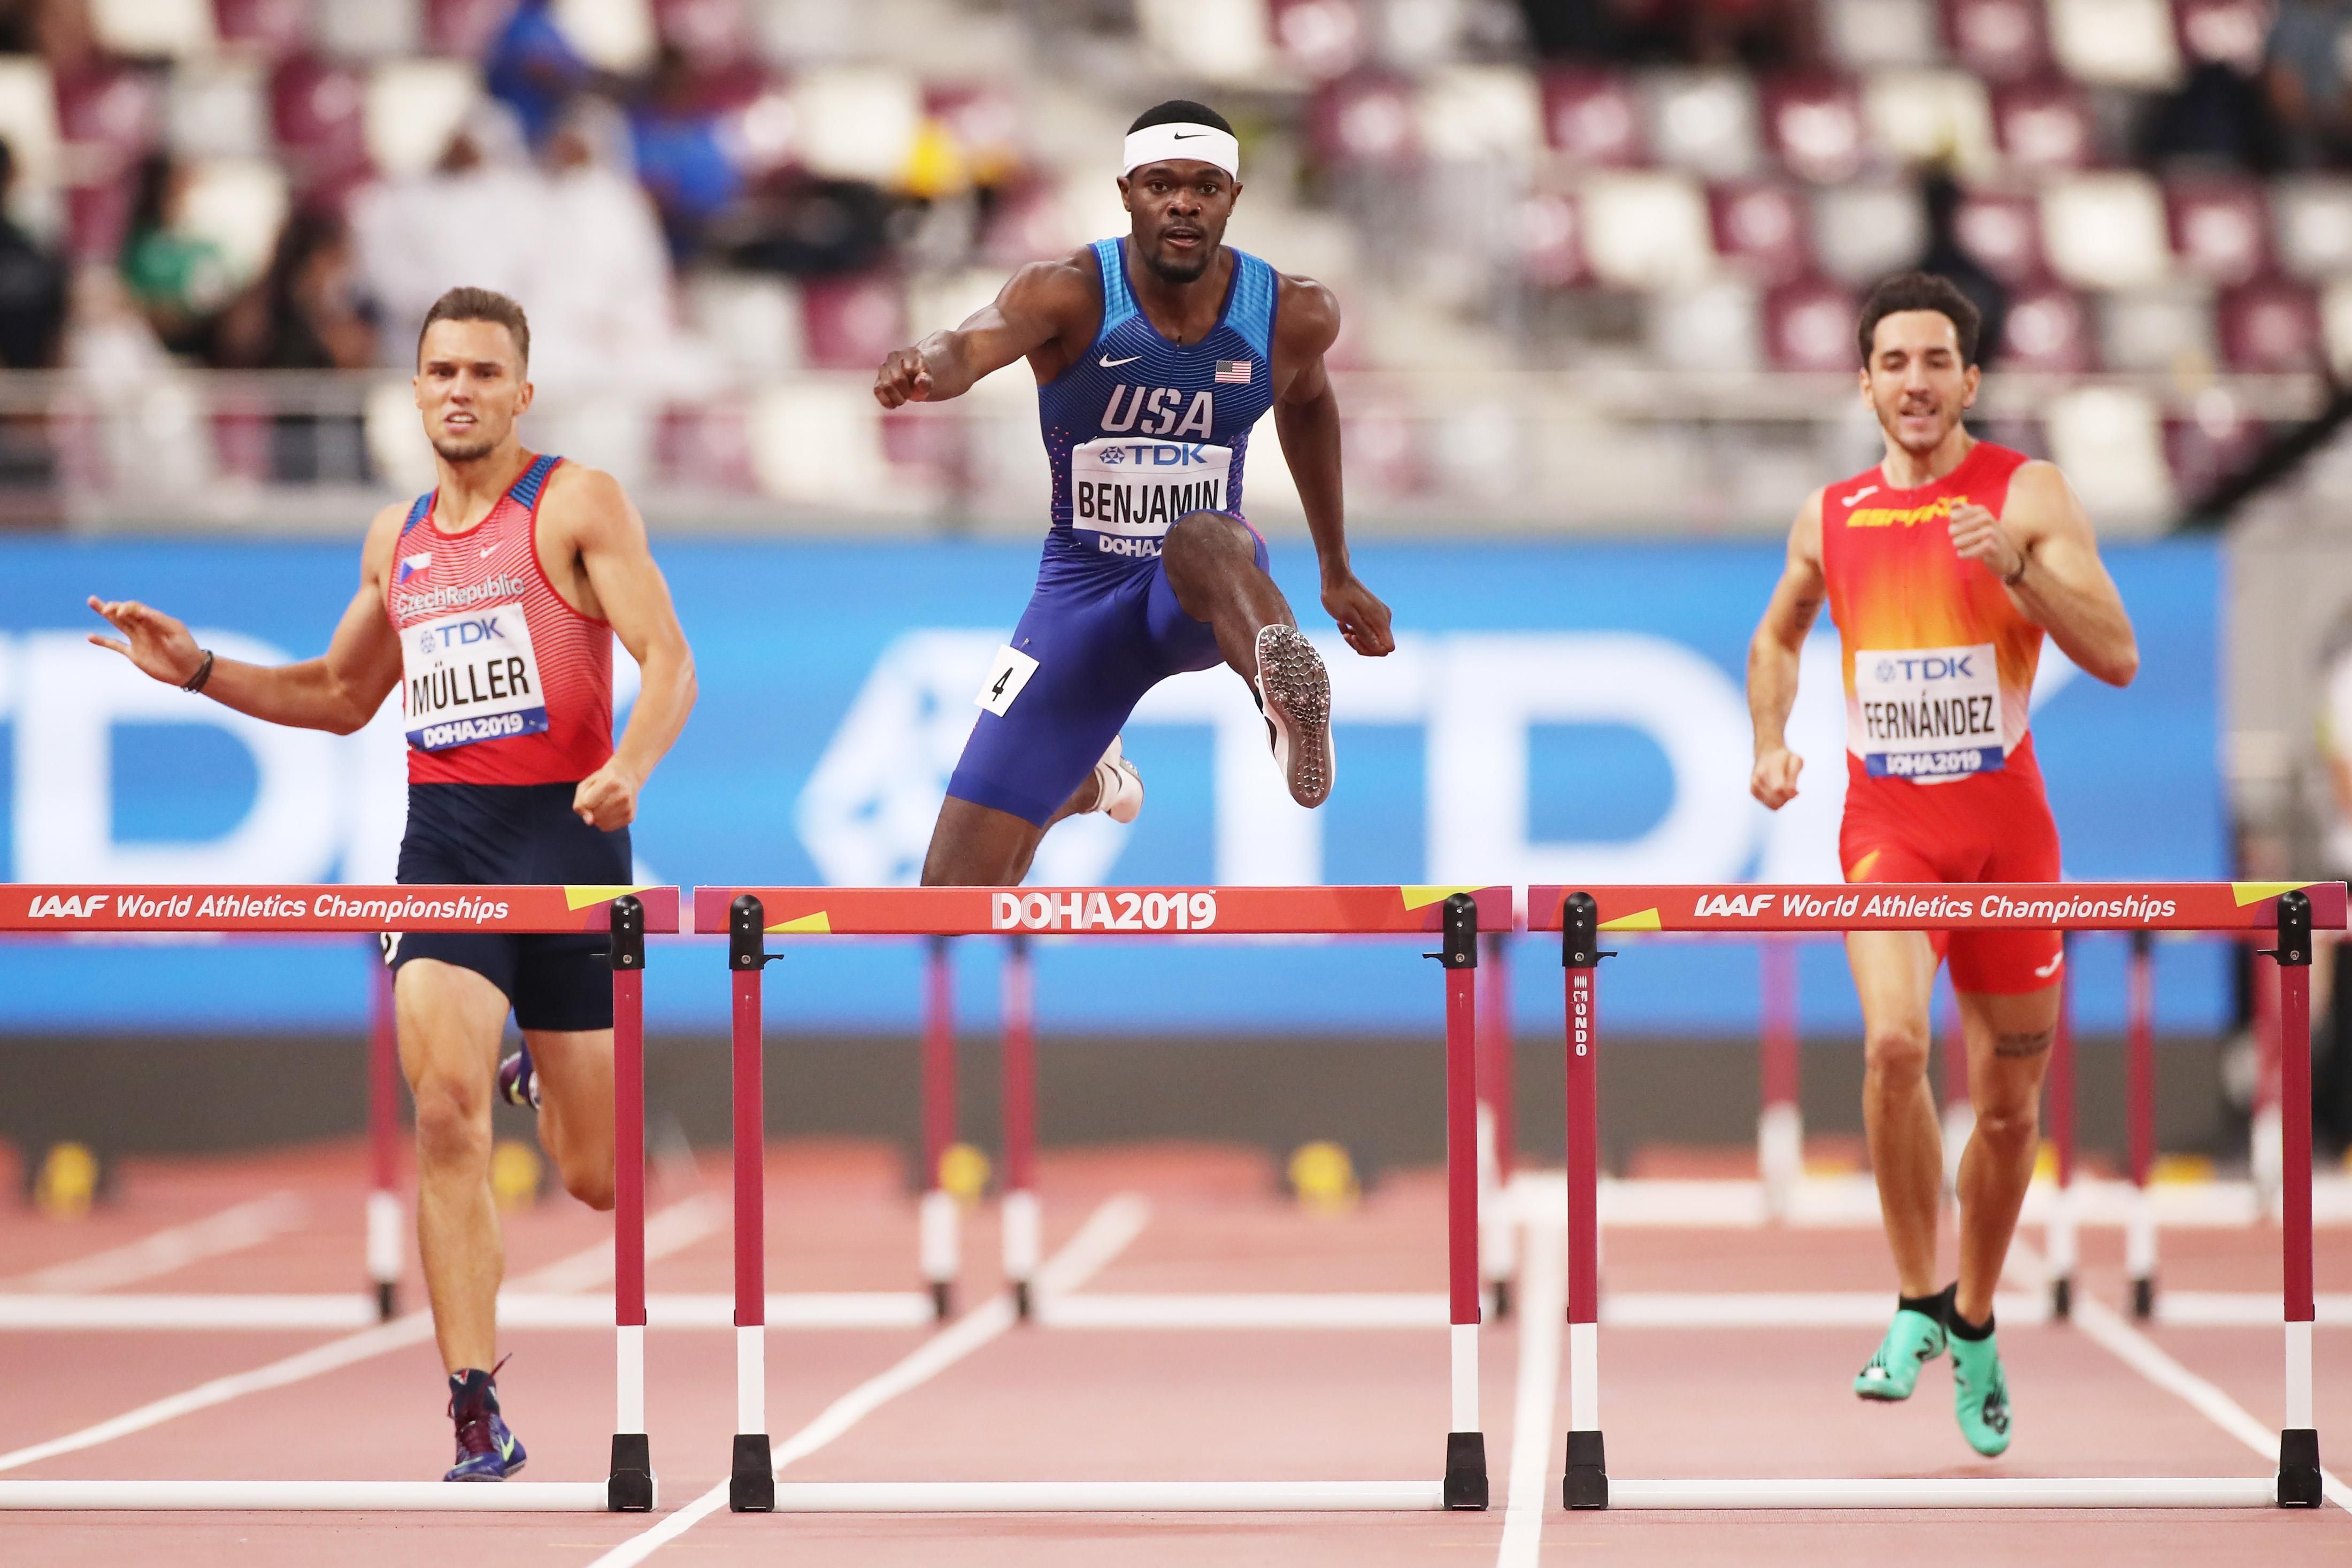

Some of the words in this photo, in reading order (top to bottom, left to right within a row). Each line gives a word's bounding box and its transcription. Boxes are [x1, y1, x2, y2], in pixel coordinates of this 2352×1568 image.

[1101, 384, 1213, 439] USA
[1125, 443, 1208, 466] TDK
[1078, 479, 1219, 525] BENJAMIN
[436, 616, 504, 647] TDK
[992, 667, 1013, 702] 4
[1897, 655, 1974, 681] TDK
[412, 657, 530, 717] MÜLLER
[422, 713, 524, 748] DOHA2019
[1865, 690, 1995, 740] FERNÁNDEZ
[28, 895, 110, 917] IAAF
[117, 894, 194, 918] World
[195, 894, 307, 917] Athletics
[313, 894, 509, 924] Championships
[992, 892, 1217, 929] DOHA2019
[1694, 894, 1776, 917] IAAF
[1783, 894, 1859, 917] World
[1861, 894, 1973, 918] Athletics
[1980, 894, 2177, 924] Championships
[1573, 990, 1588, 1056] MONDO
